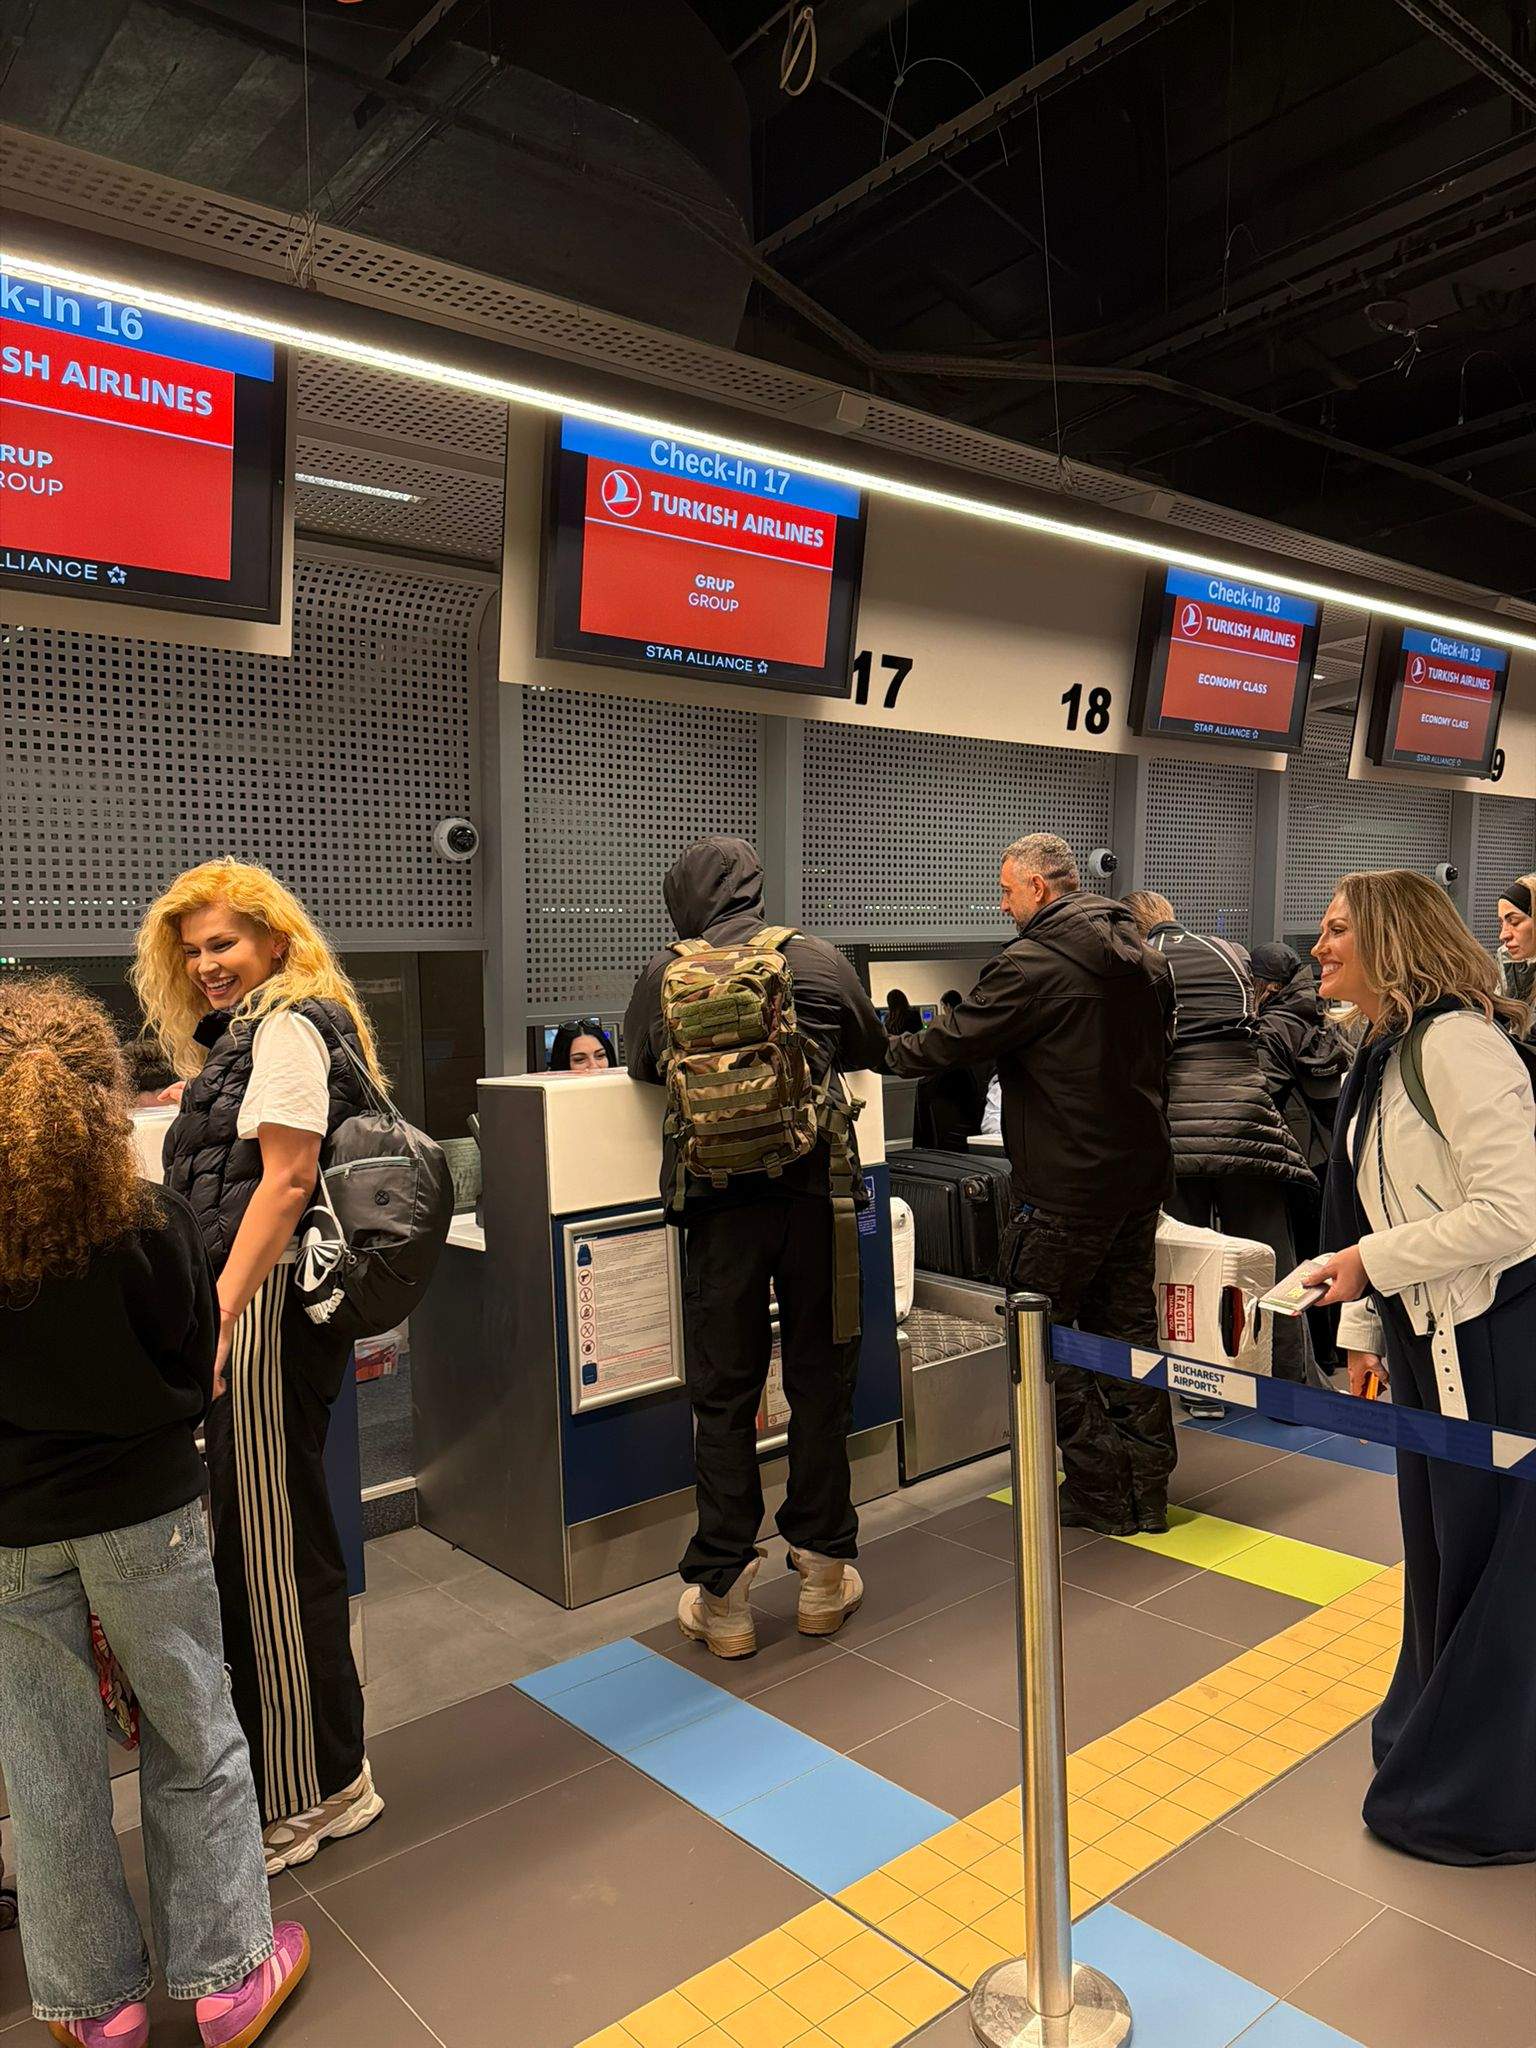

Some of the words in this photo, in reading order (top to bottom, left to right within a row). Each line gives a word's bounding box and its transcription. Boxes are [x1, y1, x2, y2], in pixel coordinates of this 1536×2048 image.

[96, 300, 143, 340] 16
[61, 361, 213, 416] AIRLINES
[650, 439, 757, 489] Check-In
[763, 467, 791, 495] 17
[650, 490, 739, 529] TURKISH
[742, 512, 824, 549] AIRLINES
[695, 573, 735, 592] GRUP
[1208, 580, 1263, 610] Check-In
[1265, 594, 1281, 614] 18
[688, 591, 739, 612] GROUP
[1206, 616, 1250, 638] TURKISH
[1252, 627, 1296, 648] AIRLINES
[646, 645, 683, 661] STAR
[686, 651, 753, 672] ALLIANCE
[1430, 637, 1469, 660] Check-In
[1470, 648, 1481, 662] 19
[853, 650, 913, 709] 17
[1198, 673, 1241, 690] ECONOMY
[1242, 680, 1268, 694] CLASS
[1428, 666, 1459, 683] TURKISH
[1459, 672, 1491, 690] AIRLINES
[1061, 682, 1112, 734] 18
[1421, 713, 1451, 727] ECONOMY
[1451, 717, 1470, 729] CLASS
[1194, 722, 1214, 734] STAR
[1214, 725, 1250, 739] ALLIANCE
[1175, 1288, 1187, 1337] FRAGILE
[1173, 1363, 1225, 1383] BUCHAREST
